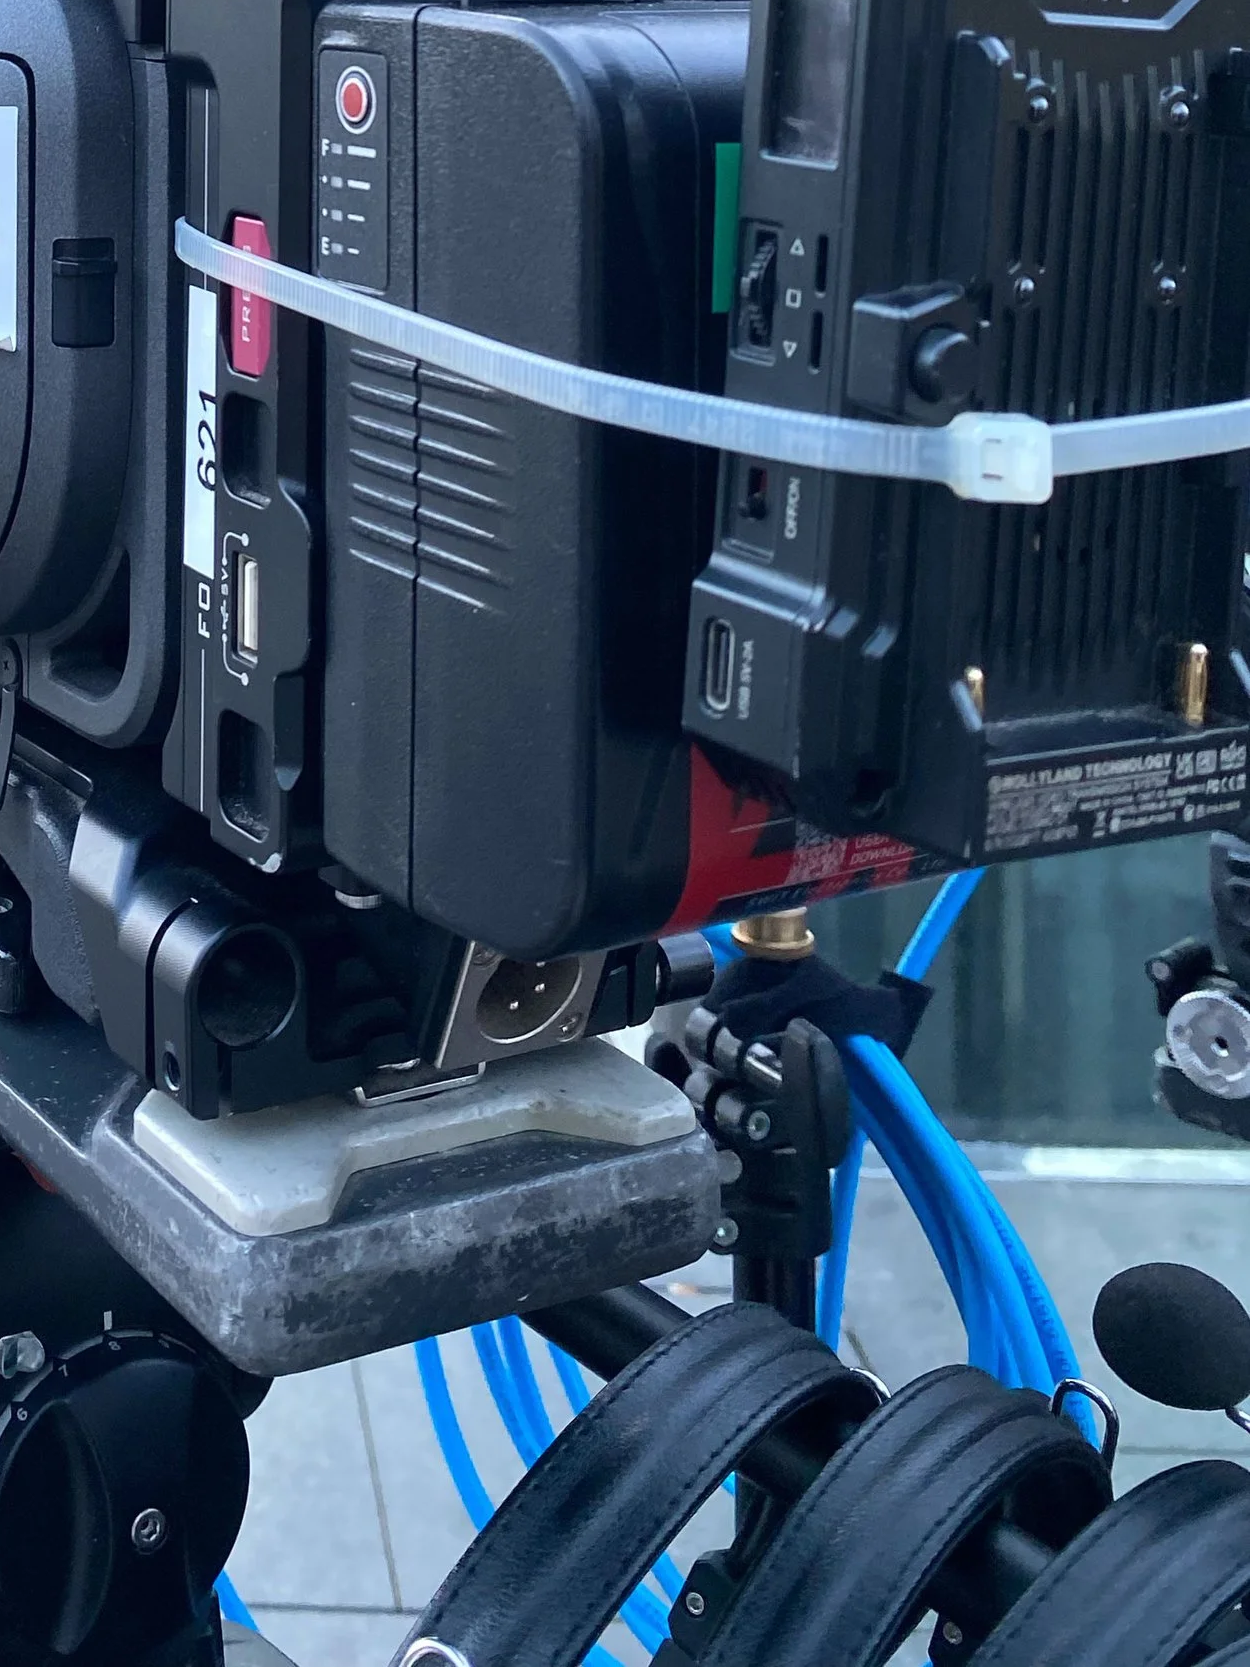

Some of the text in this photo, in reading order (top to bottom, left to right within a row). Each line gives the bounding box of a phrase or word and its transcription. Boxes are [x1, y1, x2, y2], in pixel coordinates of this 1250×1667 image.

[321, 137, 331, 157] F
[320, 235, 331, 257] E
[195, 387, 218, 492] 621
[108, 1340, 121, 1351] 8
[58, 1363, 70, 1379] 7
[16, 1406, 28, 1421] 6
